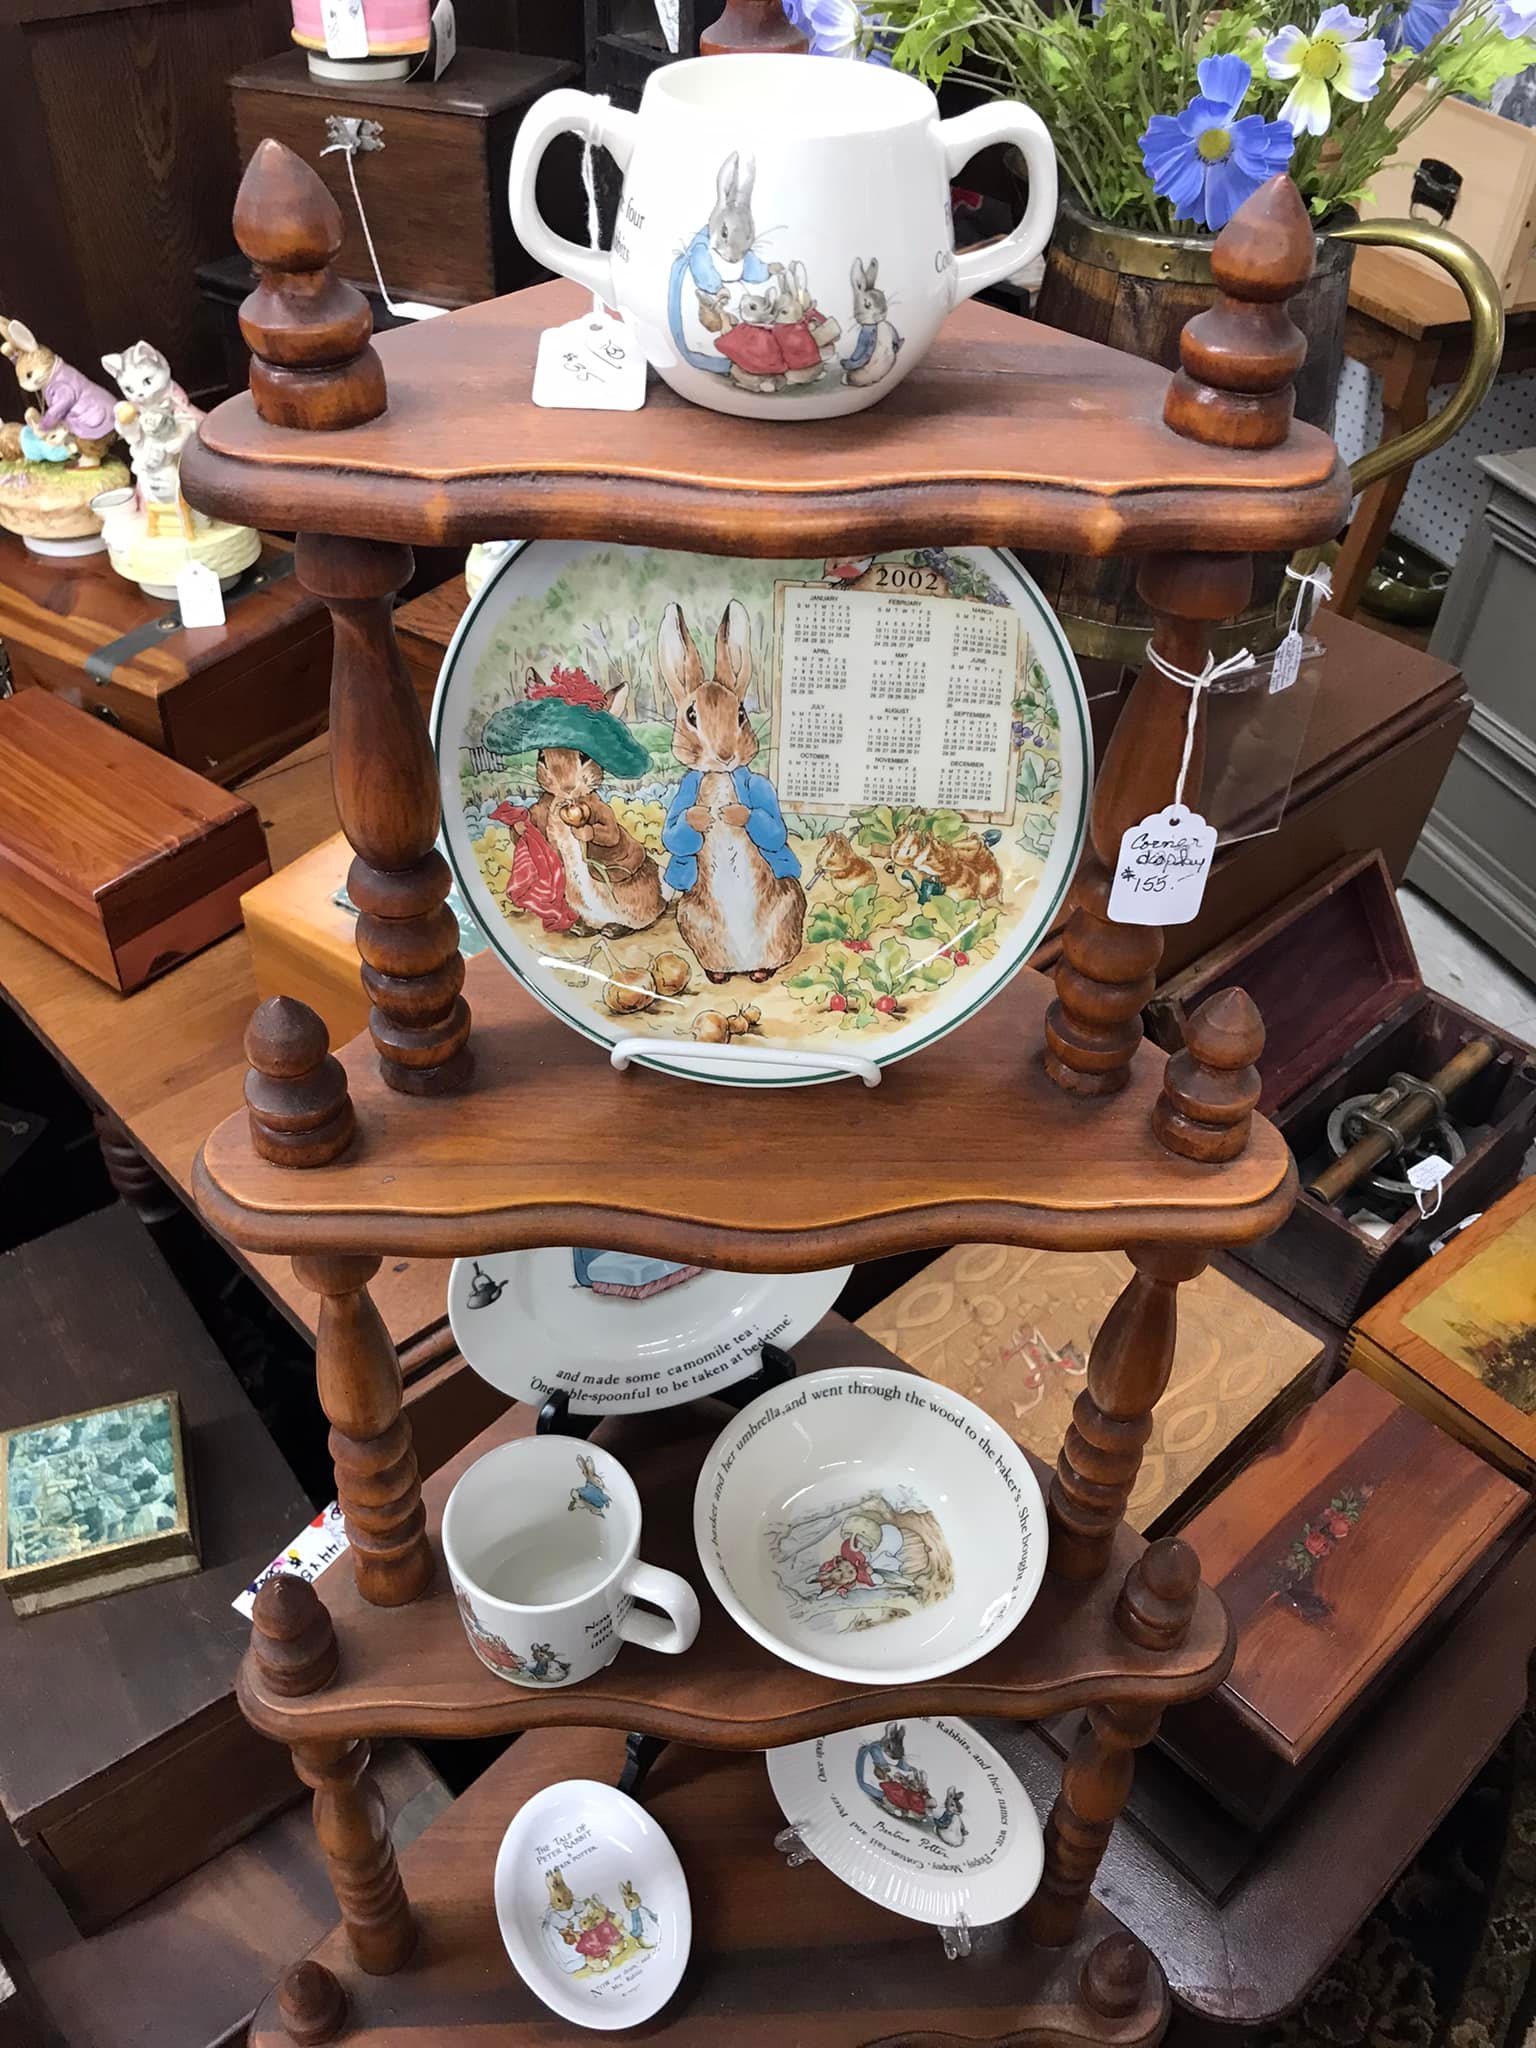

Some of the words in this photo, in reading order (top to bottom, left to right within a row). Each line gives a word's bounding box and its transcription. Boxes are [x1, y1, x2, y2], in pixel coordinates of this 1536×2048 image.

[876, 568, 938, 591] 2002
[888, 599, 922, 608] FEBRUARY
[800, 752, 830, 760] OCTOBER
[950, 760, 984, 768] DECEMBER
[556, 1368, 580, 1384] and
[583, 1374, 621, 1386] made
[625, 1370, 661, 1384] some
[667, 1342, 733, 1377] camomile
[655, 1384, 668, 1396] to
[672, 1378, 689, 1391] be
[692, 1361, 730, 1386] taken
[731, 1352, 744, 1367] at
[714, 1472, 726, 1502] and
[720, 1451, 736, 1474] her
[811, 1384, 843, 1402] went
[848, 1380, 902, 1401] through
[905, 1390, 926, 1408] the
[929, 1401, 965, 1429] wood
[964, 1424, 977, 1441] to
[977, 1436, 996, 1460] the
[1017, 1505, 1029, 1535] She
[935, 1720, 972, 1755] Rabbits,
[971, 1752, 993, 1772] and
[563, 1829, 593, 1852] RABBIT
